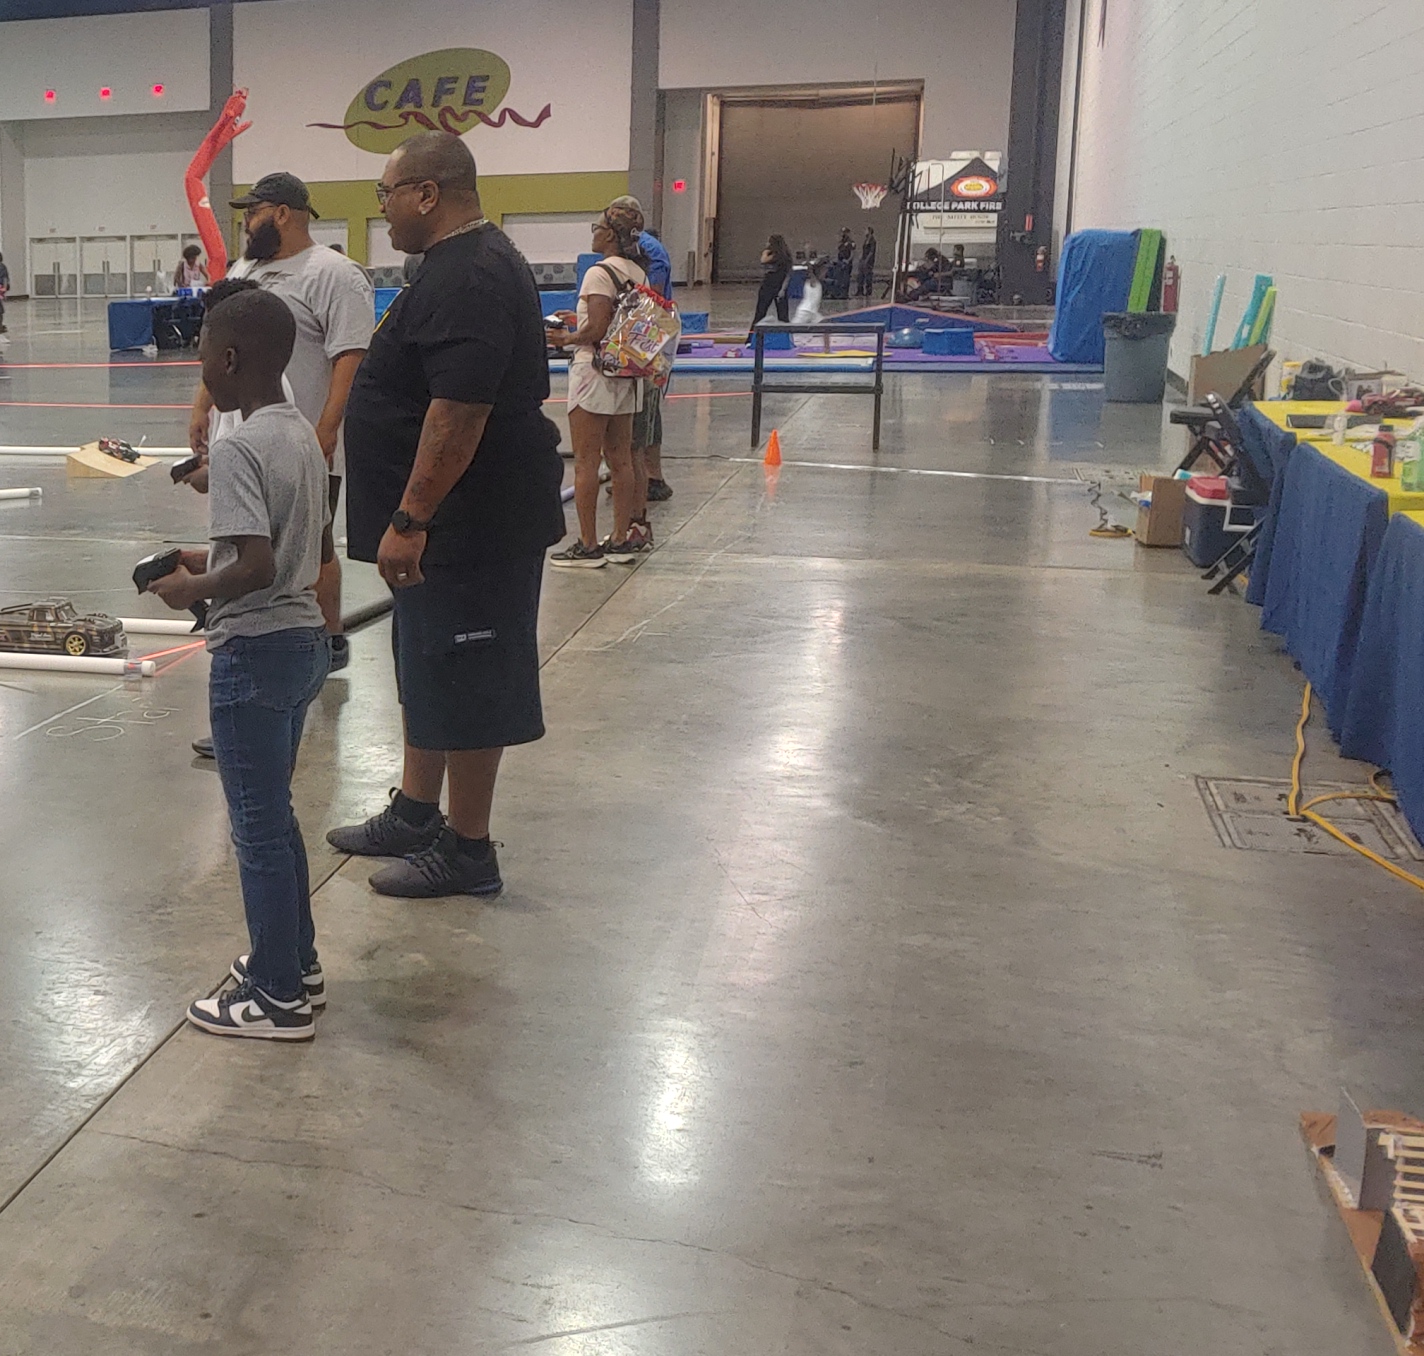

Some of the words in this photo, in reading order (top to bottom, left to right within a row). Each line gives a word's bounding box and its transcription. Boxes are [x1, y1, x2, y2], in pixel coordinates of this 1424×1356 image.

[364, 74, 490, 112] CAFE
[951, 201, 979, 210] PARK
[980, 201, 1002, 210] FIRE
